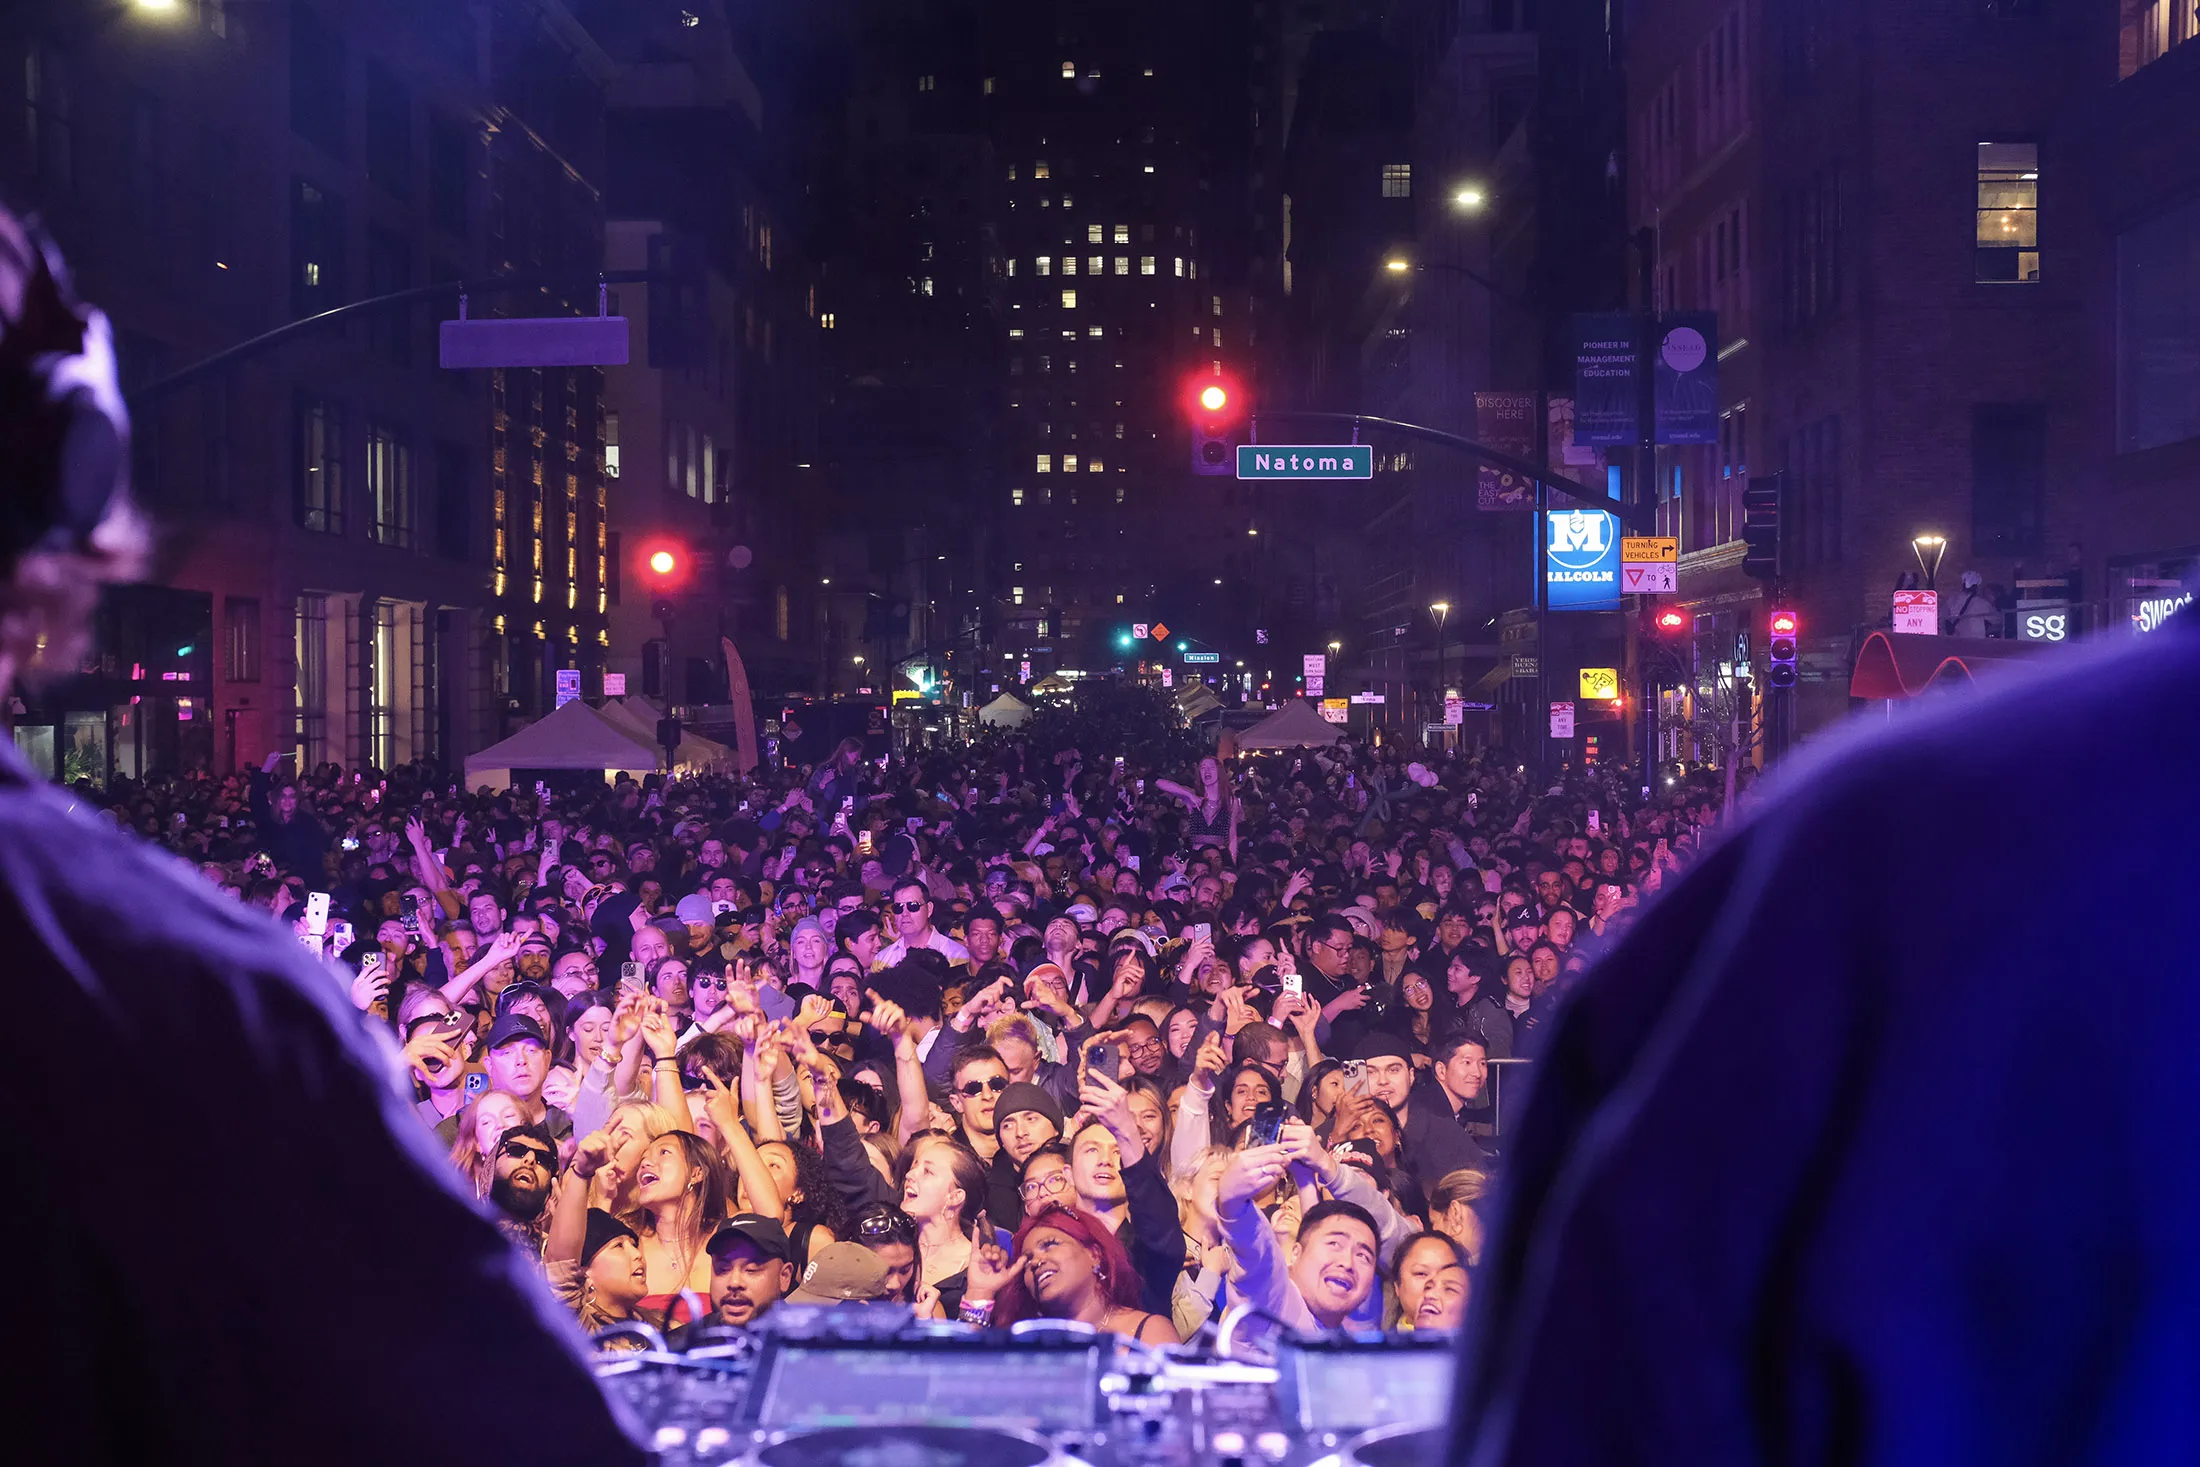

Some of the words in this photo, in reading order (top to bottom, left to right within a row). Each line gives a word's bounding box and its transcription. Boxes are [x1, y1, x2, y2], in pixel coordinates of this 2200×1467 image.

[1583, 341, 1617, 349] PIONEER
[1577, 355, 1635, 363] MANAGEMENT
[1583, 369, 1631, 377] EDUCATION
[1476, 398, 1532, 408] DISCOVER
[1496, 410, 1524, 419] HERE
[1255, 454, 1354, 470] Natoma
[1479, 481, 1496, 489] THE
[1478, 489, 1500, 497] EAST
[1478, 497, 1496, 505] CUT
[1549, 513, 1605, 552] M
[1895, 605, 1908, 613] NO
[1907, 618, 1923, 627] ANY
[2026, 614, 2066, 641] sg
[1517, 908, 1530, 920] A
